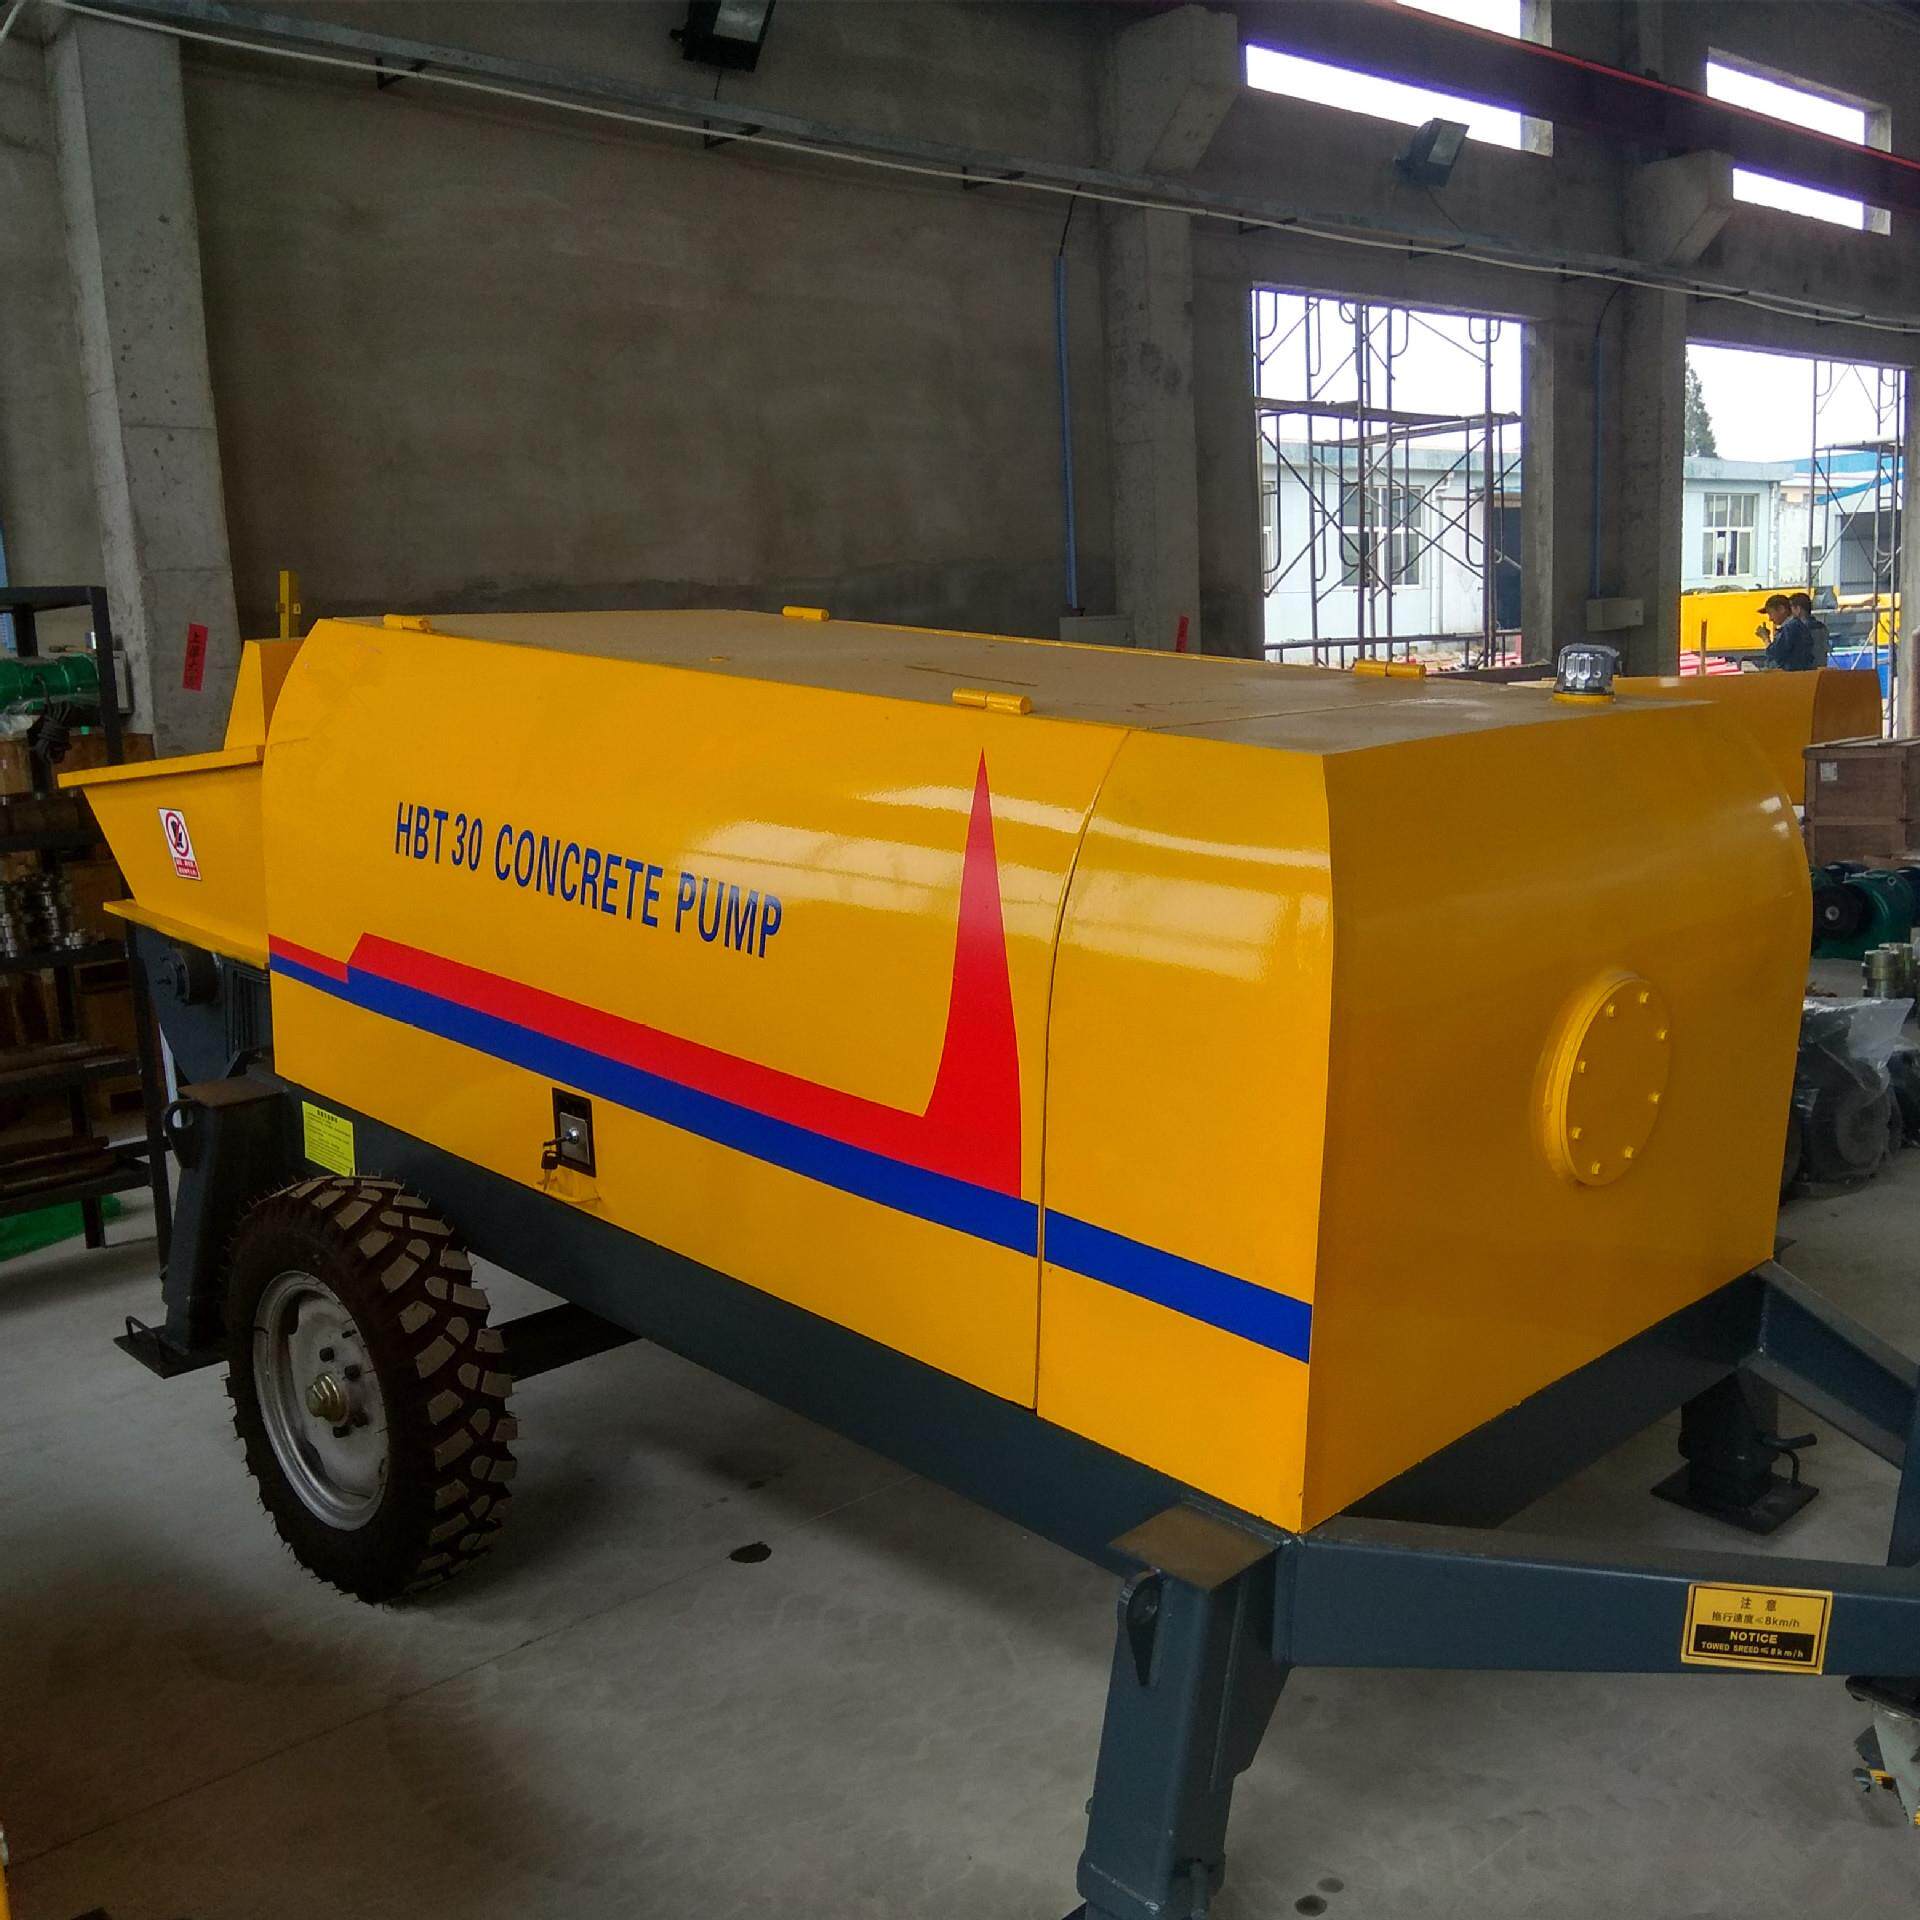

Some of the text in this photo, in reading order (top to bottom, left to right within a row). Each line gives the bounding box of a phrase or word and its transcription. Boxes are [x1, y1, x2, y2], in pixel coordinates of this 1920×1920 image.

[495, 824, 663, 928] CONCRETE
[675, 871, 782, 959] PUMP
[1729, 1631, 1778, 1645] NOTICE
[1701, 1641, 1729, 1652] TOWED
